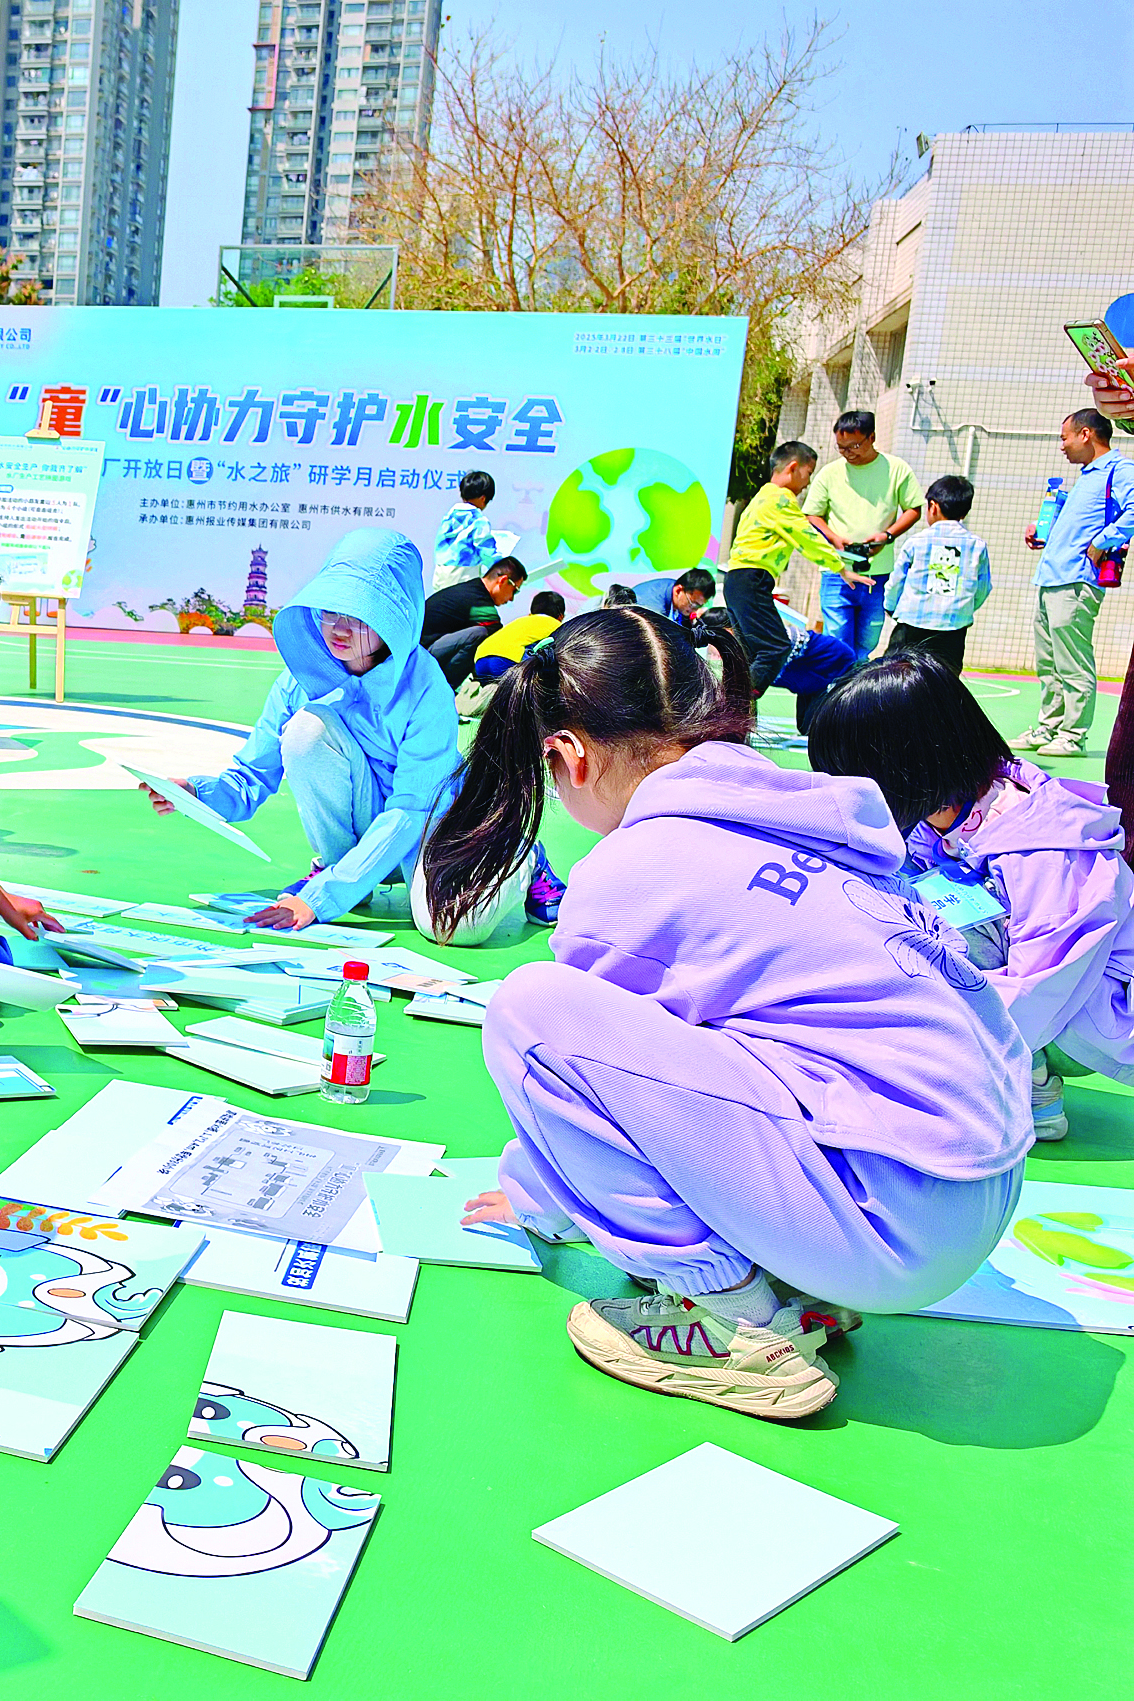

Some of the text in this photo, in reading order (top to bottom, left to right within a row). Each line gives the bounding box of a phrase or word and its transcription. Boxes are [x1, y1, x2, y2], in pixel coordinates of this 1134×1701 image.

[298, 503, 396, 518] 惠州市供水有限公司
[138, 514, 312, 531] 承办单位：惠州报业传媒集团有限公司
